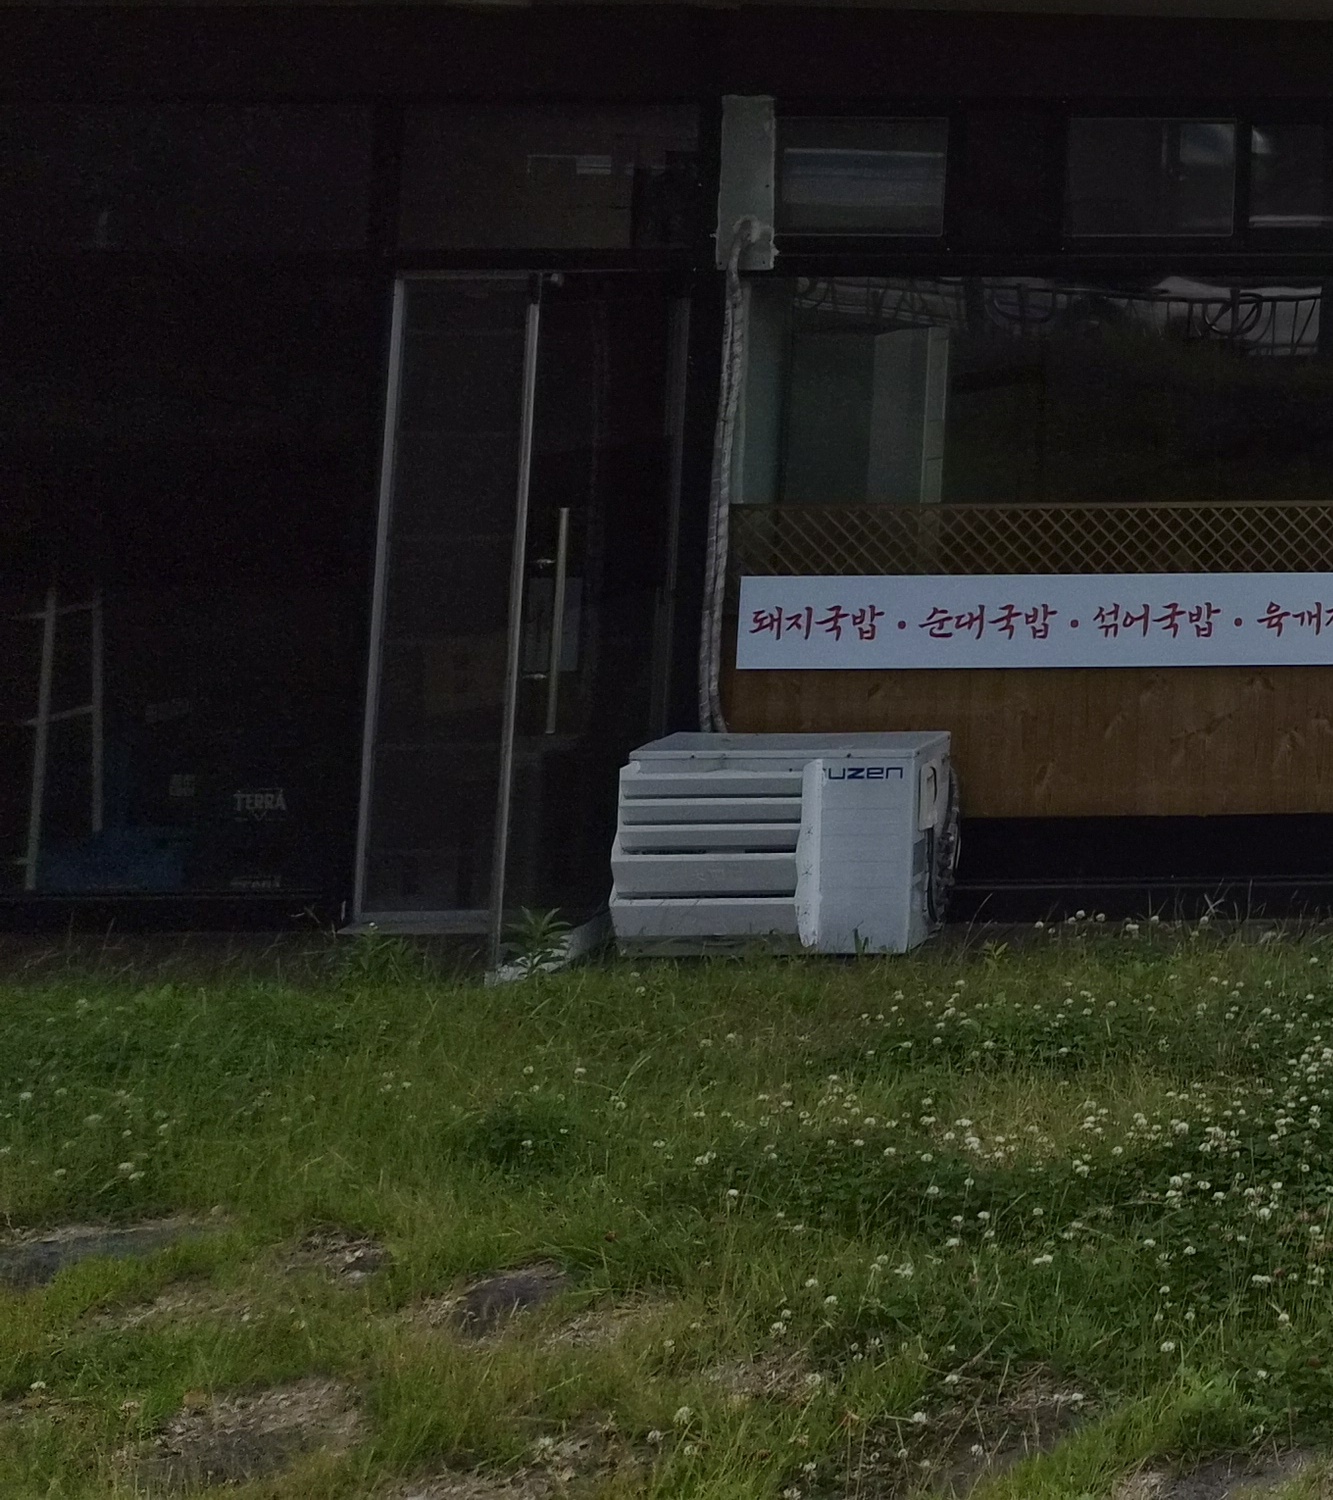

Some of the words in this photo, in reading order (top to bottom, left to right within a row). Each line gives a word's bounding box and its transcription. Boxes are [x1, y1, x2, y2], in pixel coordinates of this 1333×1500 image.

[749, 605, 885, 641] 돼지국밥
[918, 604, 1057, 640] 순대국밥
[1093, 602, 1221, 638] 섞어국밥
[823, 767, 903, 780] uzen
[233, 791, 287, 811] TERRA
